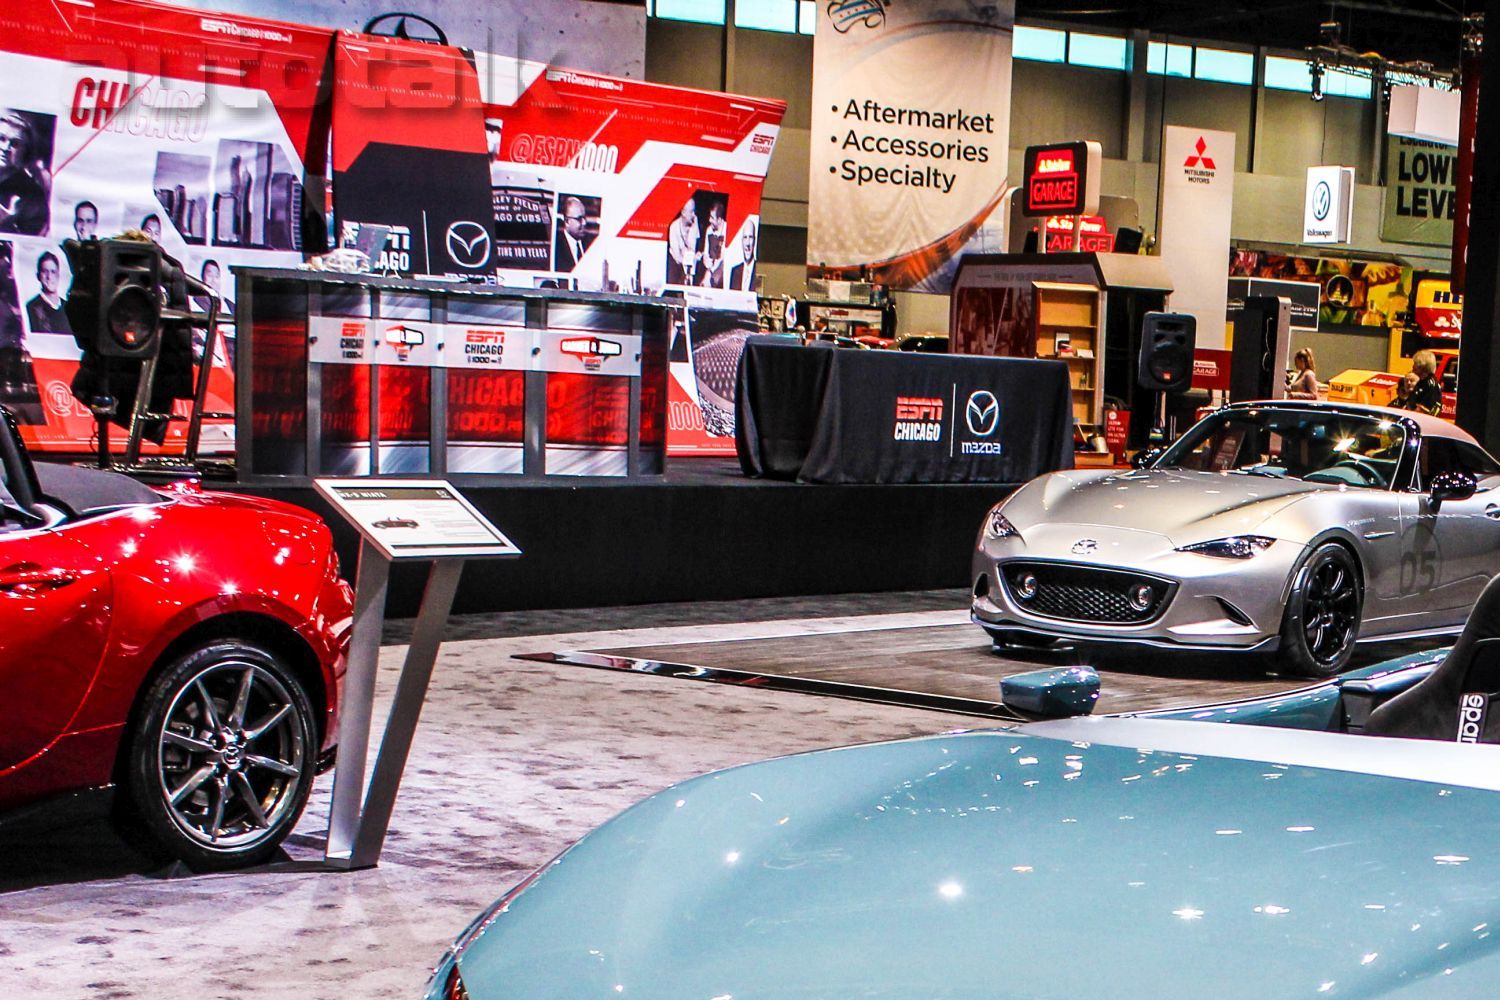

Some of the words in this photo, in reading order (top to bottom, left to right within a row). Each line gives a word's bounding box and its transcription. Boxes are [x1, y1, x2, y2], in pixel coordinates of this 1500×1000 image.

[843, 98, 994, 134] Aftermarket
[841, 129, 989, 163] Accessories
[841, 159, 956, 193] Specialty
[1034, 181, 1075, 202] GARAGE
[466, 329, 505, 344] ESPN
[464, 343, 504, 356] CHICAGO
[896, 396, 944, 421] ESPN
[894, 421, 941, 442] CHICAGO
[961, 441, 1001, 455] mazda
